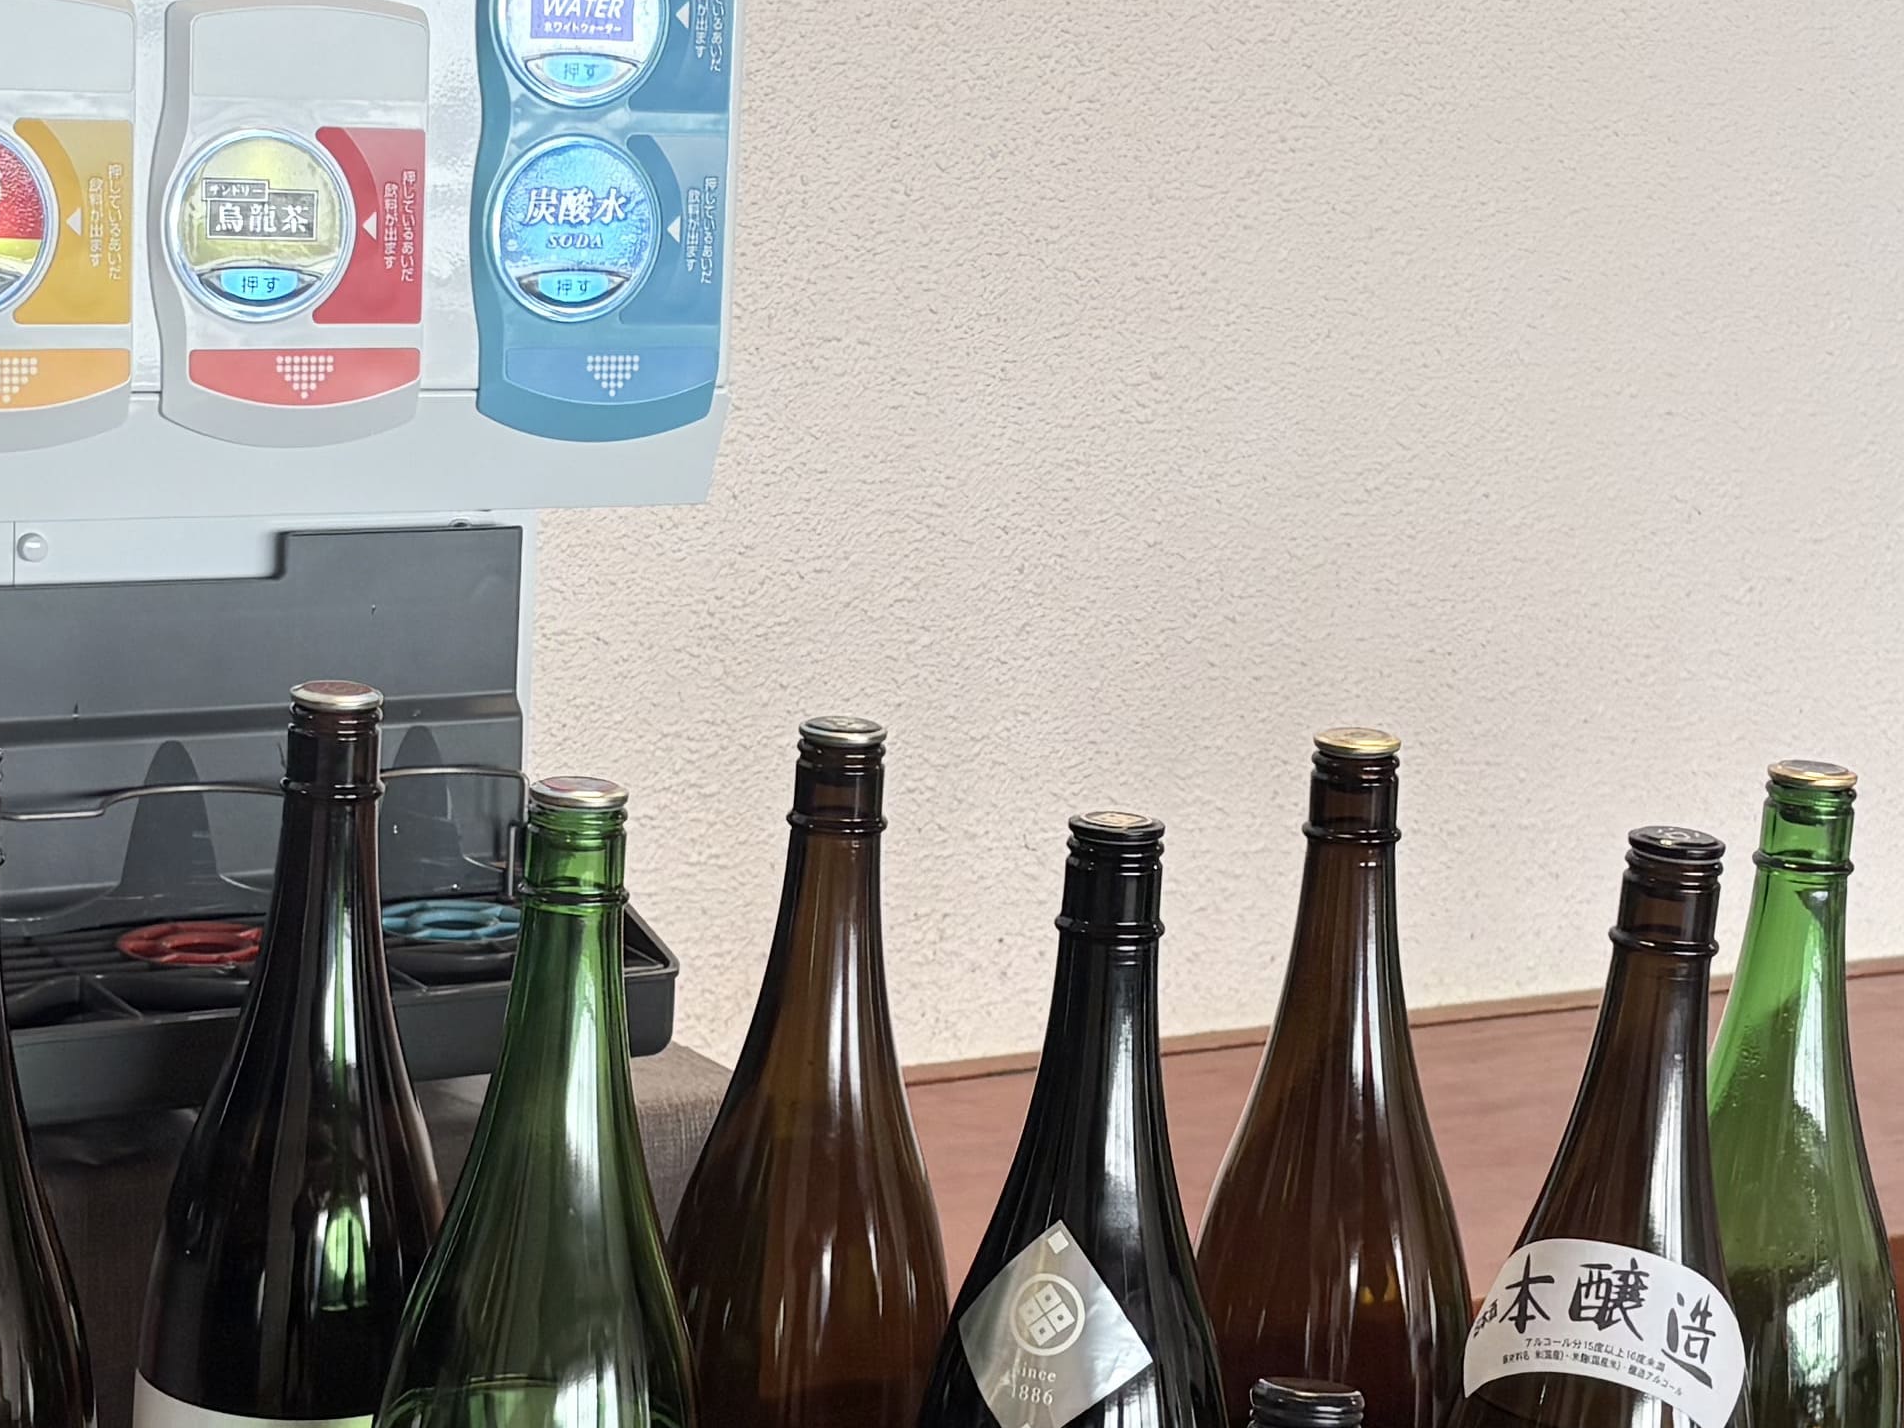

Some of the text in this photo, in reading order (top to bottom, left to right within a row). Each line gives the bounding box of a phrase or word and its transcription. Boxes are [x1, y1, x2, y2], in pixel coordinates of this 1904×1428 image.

[524, 186, 627, 225] 炭酸水
[214, 202, 312, 234] 烏龍茶
[548, 233, 604, 249] SODA
[241, 274, 281, 294] 押す
[1011, 1384, 1054, 1406] 1886
